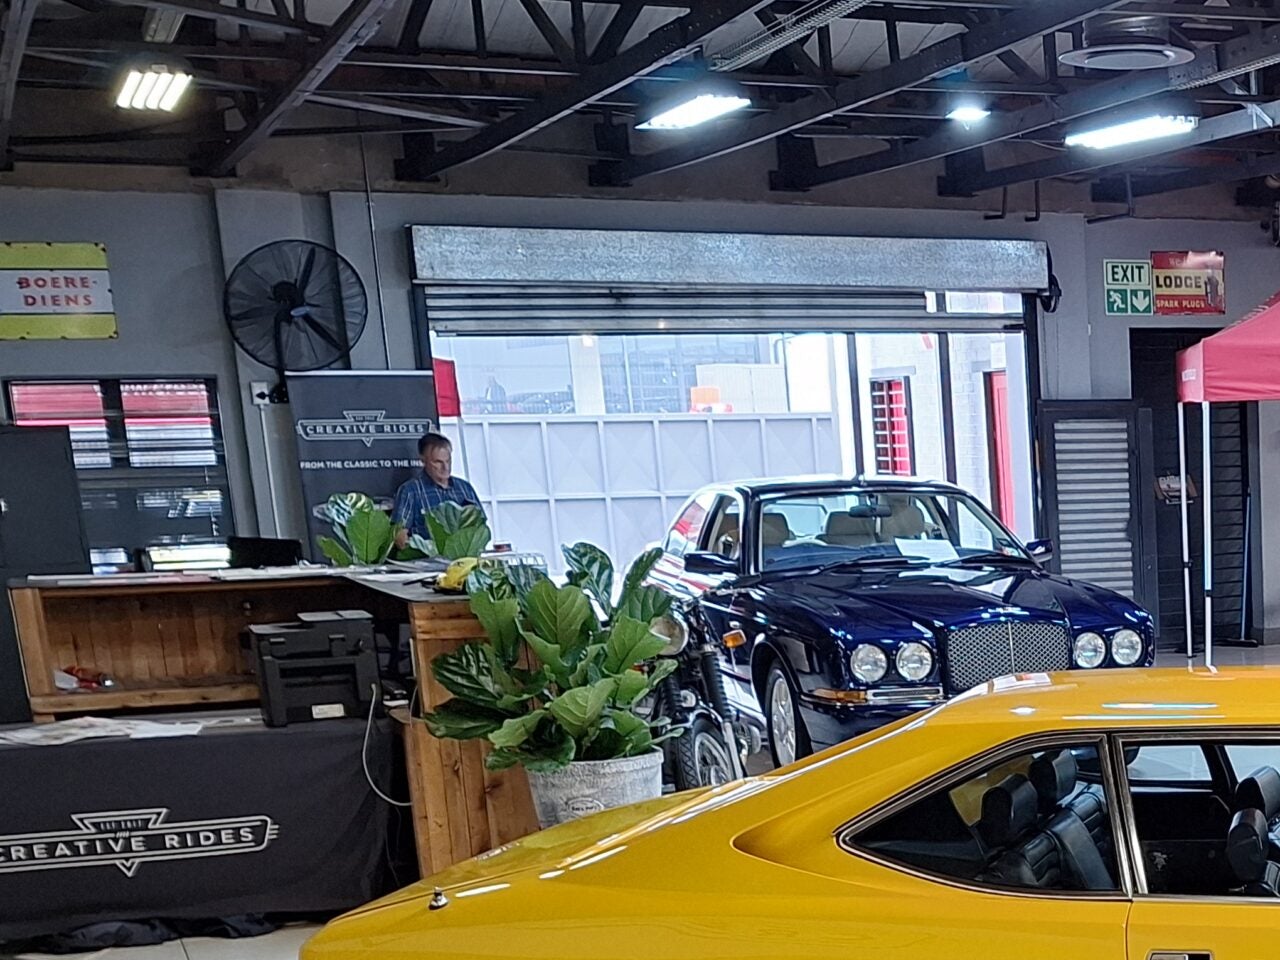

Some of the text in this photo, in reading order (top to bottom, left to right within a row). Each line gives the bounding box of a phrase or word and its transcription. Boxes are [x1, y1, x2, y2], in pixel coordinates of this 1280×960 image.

[1111, 265, 1144, 282] EXIT
[16, 276, 98, 290] BOERE-
[1155, 275, 1202, 289] LODGE
[23, 294, 92, 307] DIENS
[1156, 299, 1205, 309] SPARK PLUGS
[306, 424, 424, 434] CREATIVE RIDES
[300, 460, 325, 469] FROM
[326, 461, 342, 469] THE
[344, 460, 378, 469] CLASSIC
[380, 460, 391, 468] TO
[393, 459, 409, 467] THE
[0, 827, 254, 861] REATIVE RIDES
